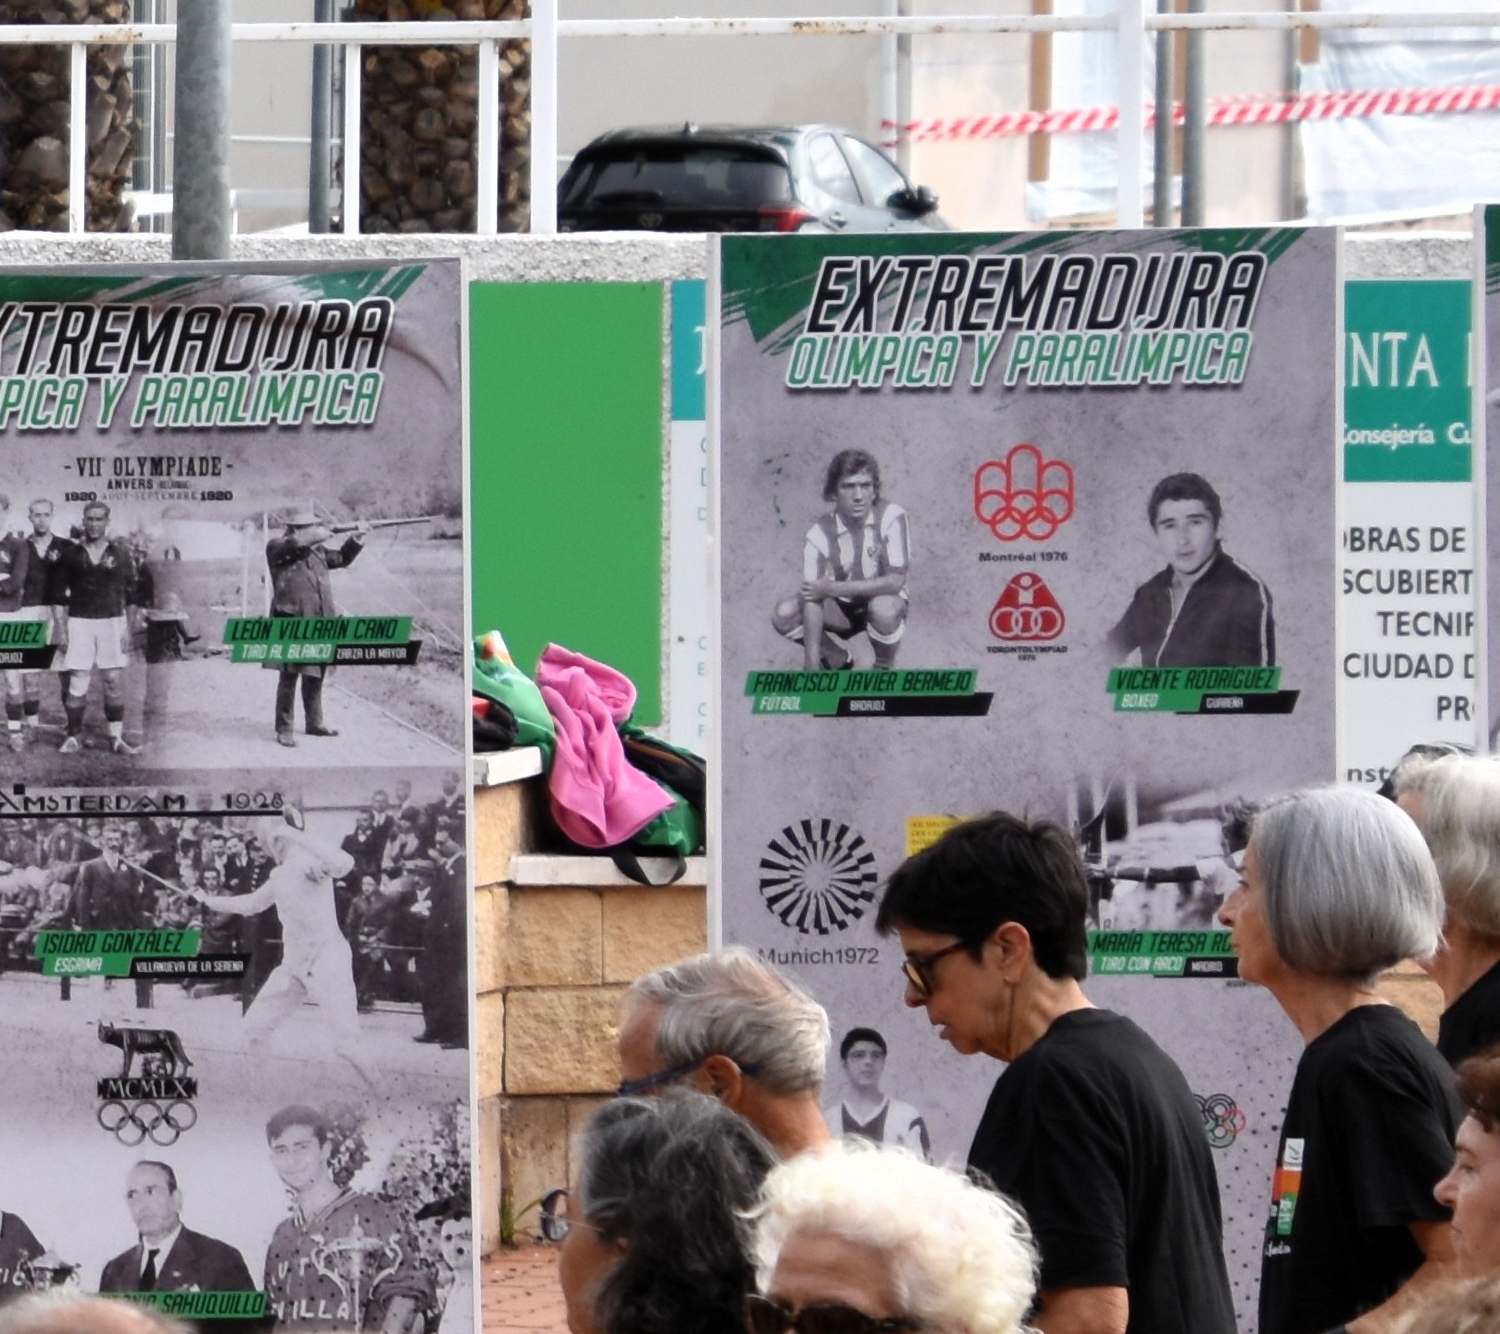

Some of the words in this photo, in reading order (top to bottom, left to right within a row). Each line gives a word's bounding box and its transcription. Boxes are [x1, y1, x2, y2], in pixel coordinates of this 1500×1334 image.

[804, 256, 1263, 335] EXTREMADURA
[971, 333, 999, 385] Y
[1004, 321, 1253, 386] PARALÍMPICA
[1343, 331, 1440, 388] NTA
[99, 375, 124, 427] Y
[131, 360, 384, 427] PARALÍMPICA
[113, 456, 222, 477] OLYMPIADE
[107, 478, 154, 490] ANVERS
[64, 491, 97, 502] 1920
[201, 490, 234, 501] 1920
[1430, 527, 1466, 553] DE
[979, 552, 1036, 562] Montréal
[1041, 551, 1068, 561] 1976
[232, 616, 272, 641] LEÓN
[279, 614, 349, 640] VILLARÍN
[354, 618, 398, 639] CANO
[242, 644, 267, 659] TIRO
[271, 644, 282, 659] AL
[287, 644, 332, 659] BLANCO
[365, 648, 375, 659] LA
[378, 647, 407, 659] MAYOR
[1343, 653, 1454, 679] CIUDAD
[753, 672, 839, 693] FRANCISCO
[843, 672, 895, 692] JAVIER
[901, 671, 972, 691] BERMEJO
[1116, 670, 1181, 690] VICENTE
[1184, 666, 1276, 689] RODRÍGUEZ
[760, 694, 800, 711] FÚTBOL
[1122, 693, 1159, 708] BOXEO
[1437, 695, 1475, 720] PR
[221, 792, 283, 809] 1928
[43, 933, 96, 954] ISIDRO
[1093, 930, 1143, 953] MARÍA
[1150, 933, 1207, 953] TERESA
[55, 958, 103, 973] ESGRIMA
[1102, 957, 1126, 971] TIRO
[1128, 957, 1150, 971] CON
[1153, 957, 1184, 971] ARCO
[107, 1080, 189, 1098] MCMLX
[163, 1293, 265, 1314] SAHUQUILLO
